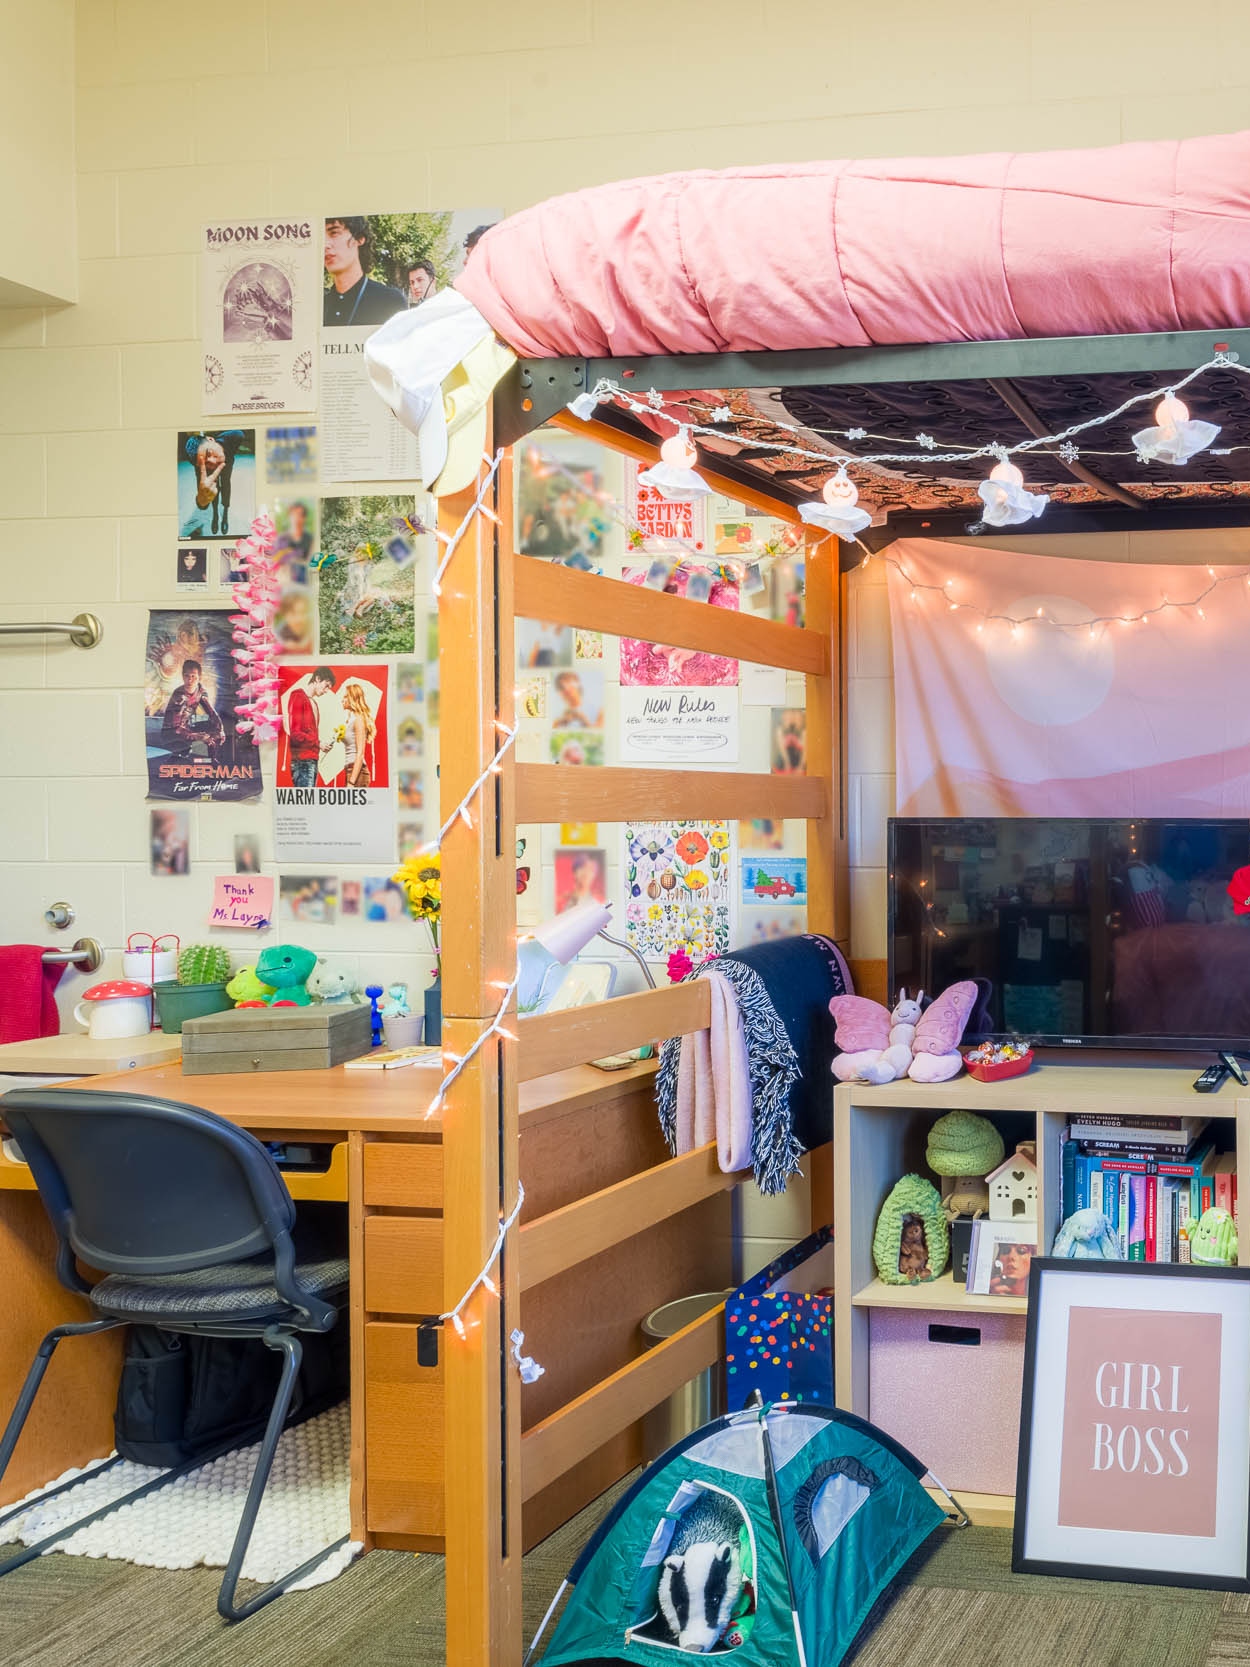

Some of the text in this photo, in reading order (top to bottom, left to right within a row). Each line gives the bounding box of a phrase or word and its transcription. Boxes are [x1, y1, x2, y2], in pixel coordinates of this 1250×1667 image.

[206, 222, 311, 243] MOON SONG
[322, 343, 352, 354] TELL
[231, 401, 285, 411] PHOEBE BRIDGERS
[159, 764, 254, 779] SPIDER-MAN
[276, 788, 367, 806] WARM BODIES
[223, 883, 255, 895] Thank
[229, 896, 248, 907] you
[1102, 1119, 1121, 1127] HUGO
[1095, 1141, 1120, 1149] SCREAM
[1095, 1361, 1190, 1413] GIRL
[1089, 1422, 1190, 1477] BOSS
